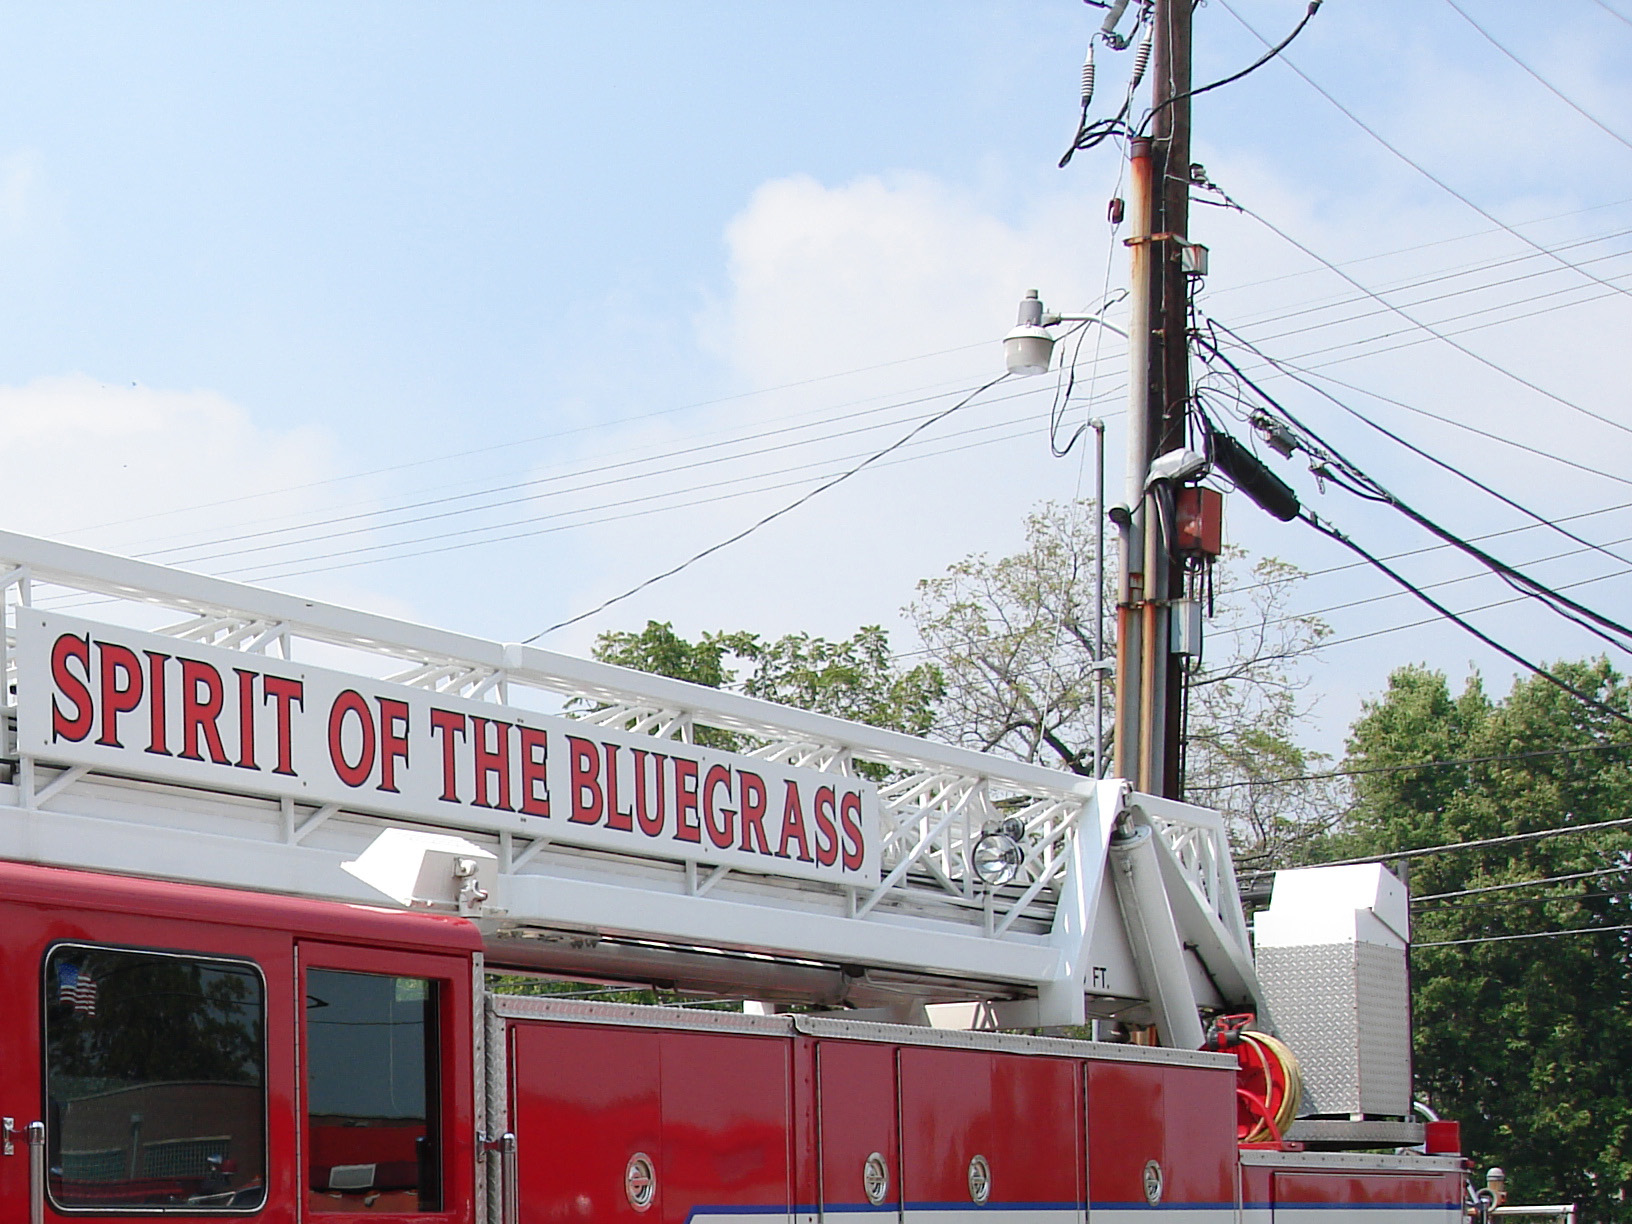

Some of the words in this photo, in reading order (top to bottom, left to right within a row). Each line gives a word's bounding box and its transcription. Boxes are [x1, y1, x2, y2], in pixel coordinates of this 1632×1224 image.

[51, 631, 304, 778] SPIRIT
[327, 688, 410, 794] OF
[430, 706, 551, 819] THE
[564, 733, 866, 873] BLUEGRASS
[1092, 966, 1110, 990] FT.
